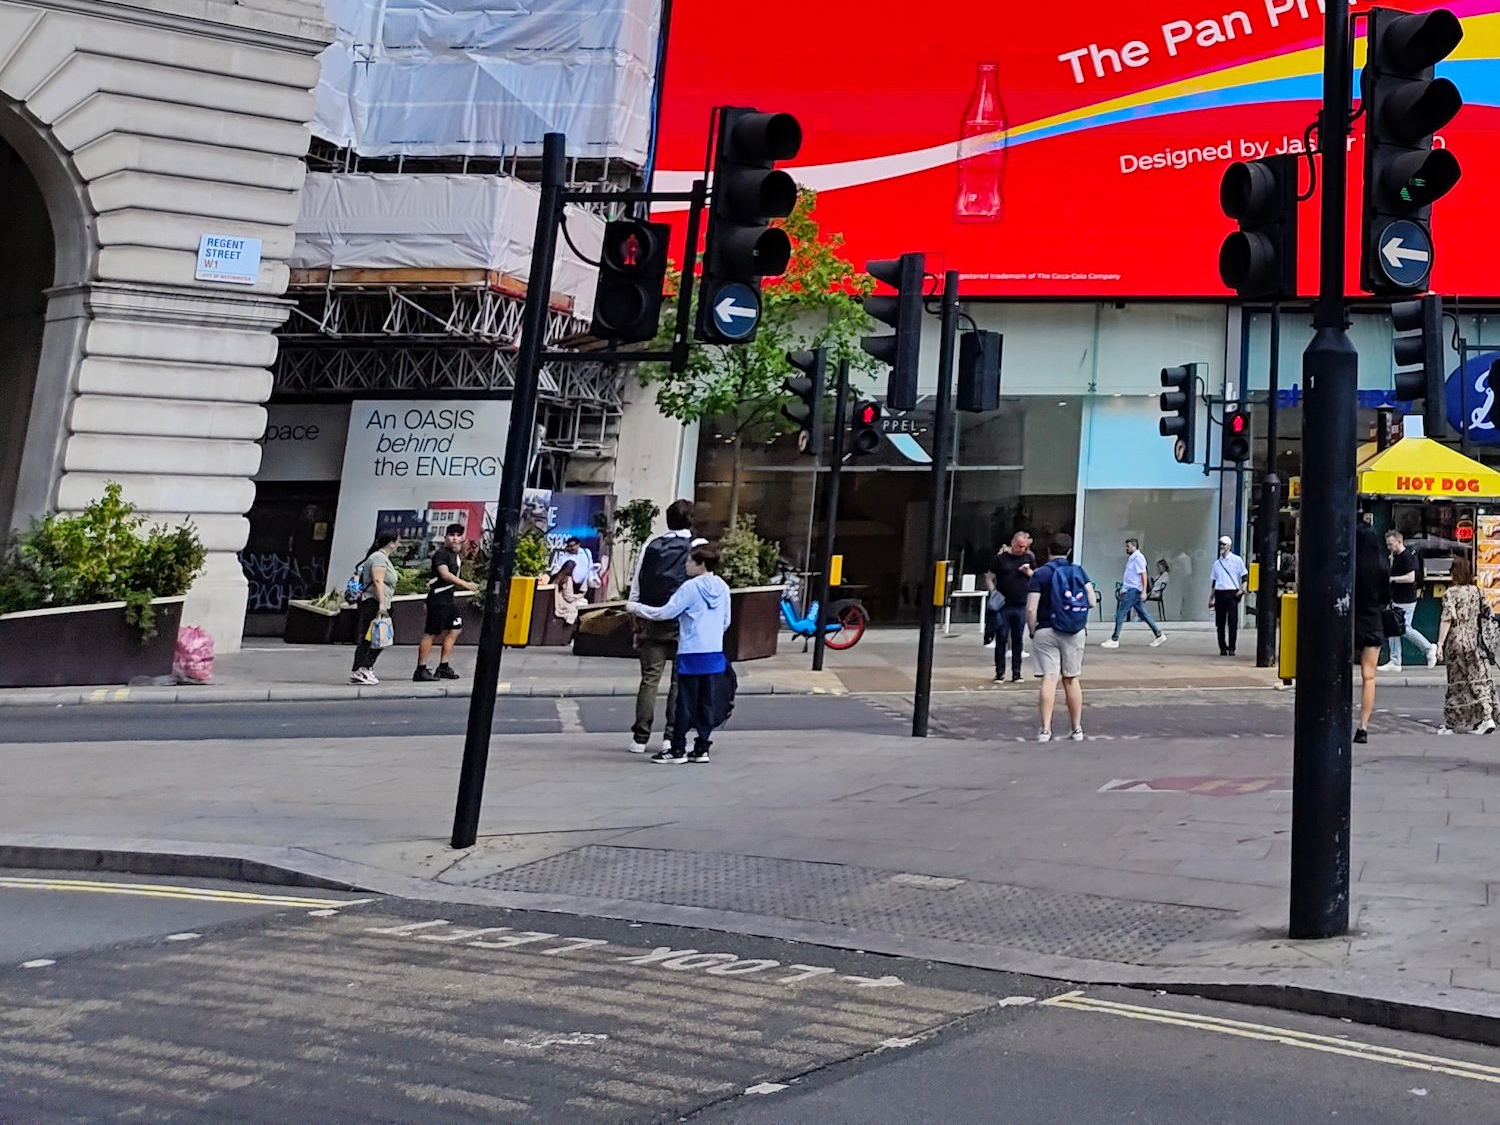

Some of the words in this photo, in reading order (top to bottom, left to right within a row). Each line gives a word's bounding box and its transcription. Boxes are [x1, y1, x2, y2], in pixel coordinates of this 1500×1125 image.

[1058, 39, 1150, 84] The
[1160, 10, 1253, 57] Pan
[1120, 140, 1233, 174] Designed
[1240, 137, 1270, 159] by
[1275, 135, 1356, 156] Jasr
[207, 237, 245, 250] REGENT
[204, 259, 219, 268] W1
[205, 248, 242, 260] STREET
[366, 409, 397, 430] An
[404, 409, 475, 430] OASIS
[882, 419, 917, 431] PPEL
[264, 424, 320, 443] pace
[376, 433, 454, 453] behind
[374, 457, 409, 476] the
[1396, 476, 1435, 491] HOT
[1442, 478, 1480, 493] DOG
[364, 919, 608, 955] LEFT
[618, 947, 836, 984] LOOK
